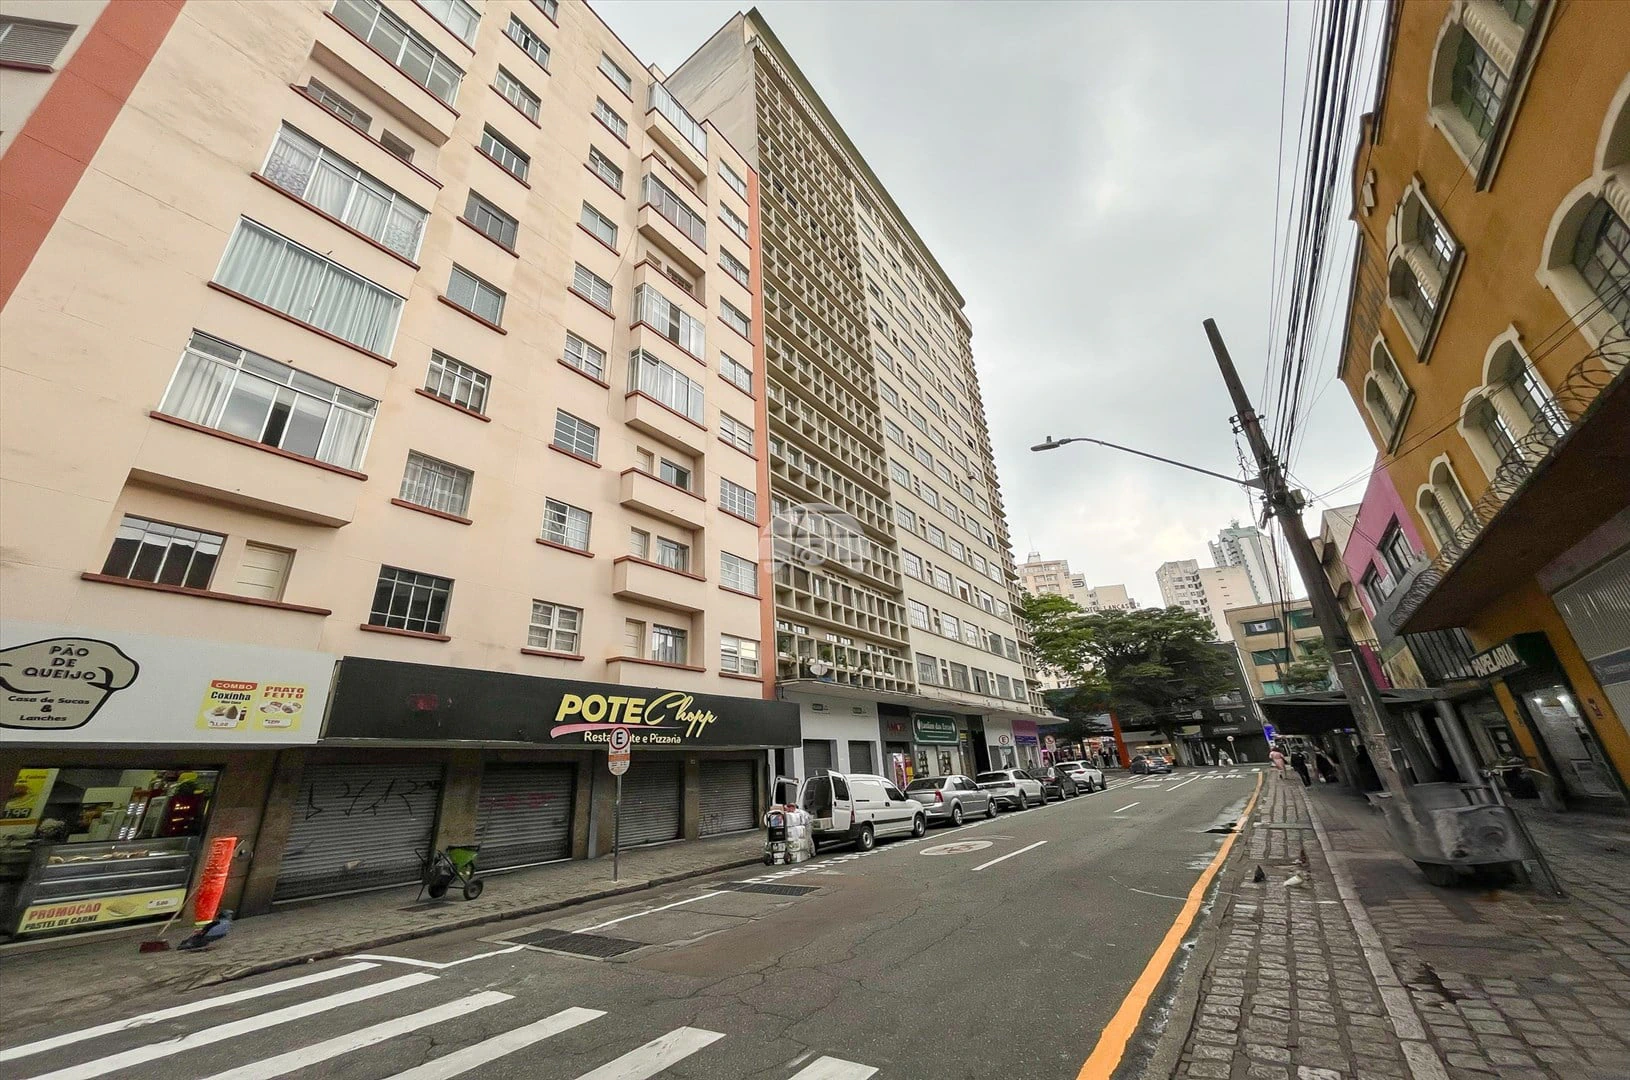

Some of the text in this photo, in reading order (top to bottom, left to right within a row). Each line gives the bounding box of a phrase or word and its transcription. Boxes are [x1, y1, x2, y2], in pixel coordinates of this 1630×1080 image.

[48, 643, 89, 657] PÃO
[51, 657, 77, 668] DE
[1471, 643, 1520, 678] PAPELARIA
[23, 667, 96, 680] QUEIJO
[215, 682, 253, 690] COMBO
[7, 695, 37, 704] Casa
[40, 696, 54, 704] de
[210, 691, 251, 701] Coxinha
[40, 704, 52, 713] &
[554, 691, 718, 738] POTE Chopp
[616, 731, 623, 744] E
[642, 735, 648, 743] e
[649, 733, 682, 744] Pizzaria
